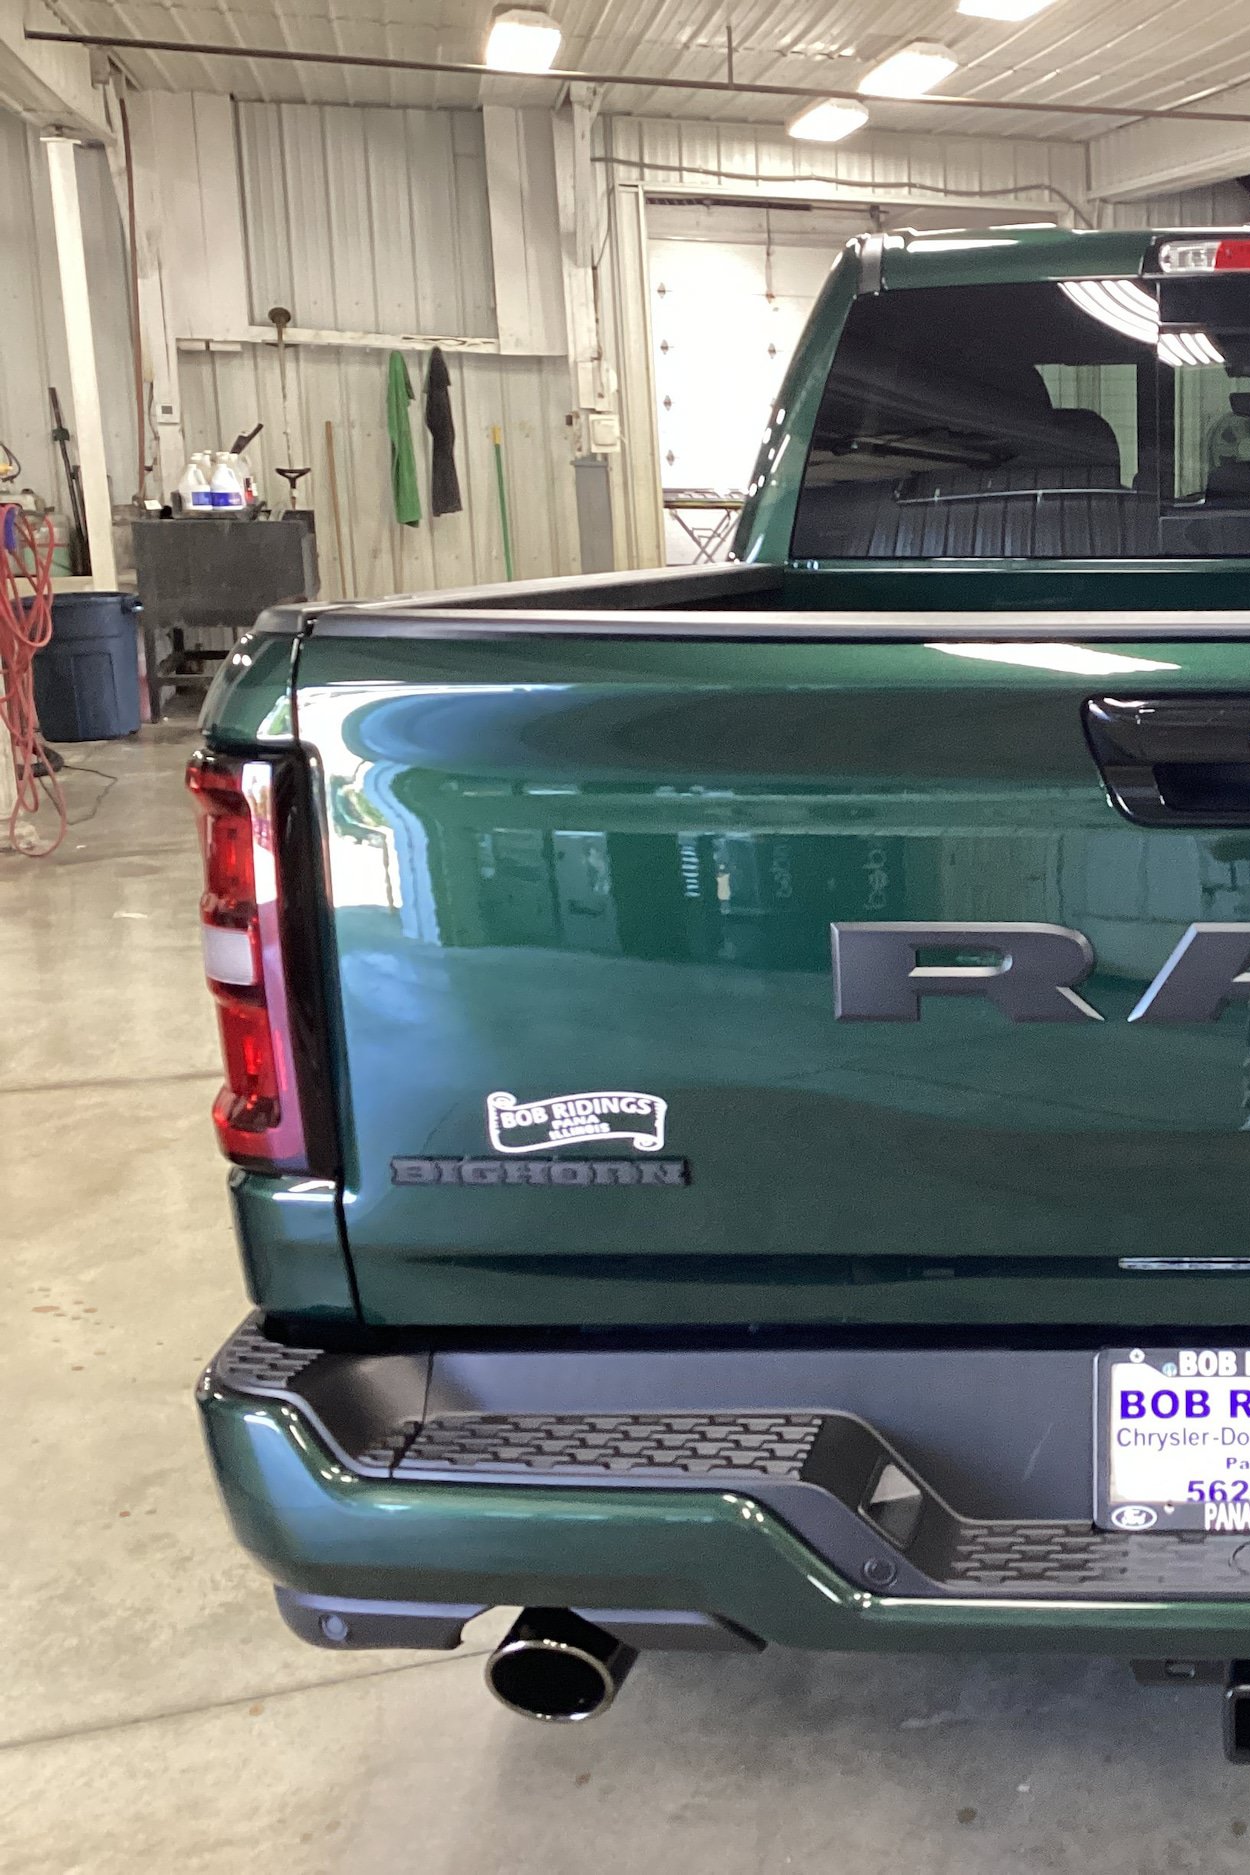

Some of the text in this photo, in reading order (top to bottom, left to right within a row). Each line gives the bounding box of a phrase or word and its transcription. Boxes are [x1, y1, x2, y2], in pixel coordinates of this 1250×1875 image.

[499, 1097, 652, 1129] BOB RIDINGS
[552, 1114, 600, 1129] PANA
[1178, 1350, 1237, 1377] BOB
[1119, 1389, 1211, 1419] BOB
